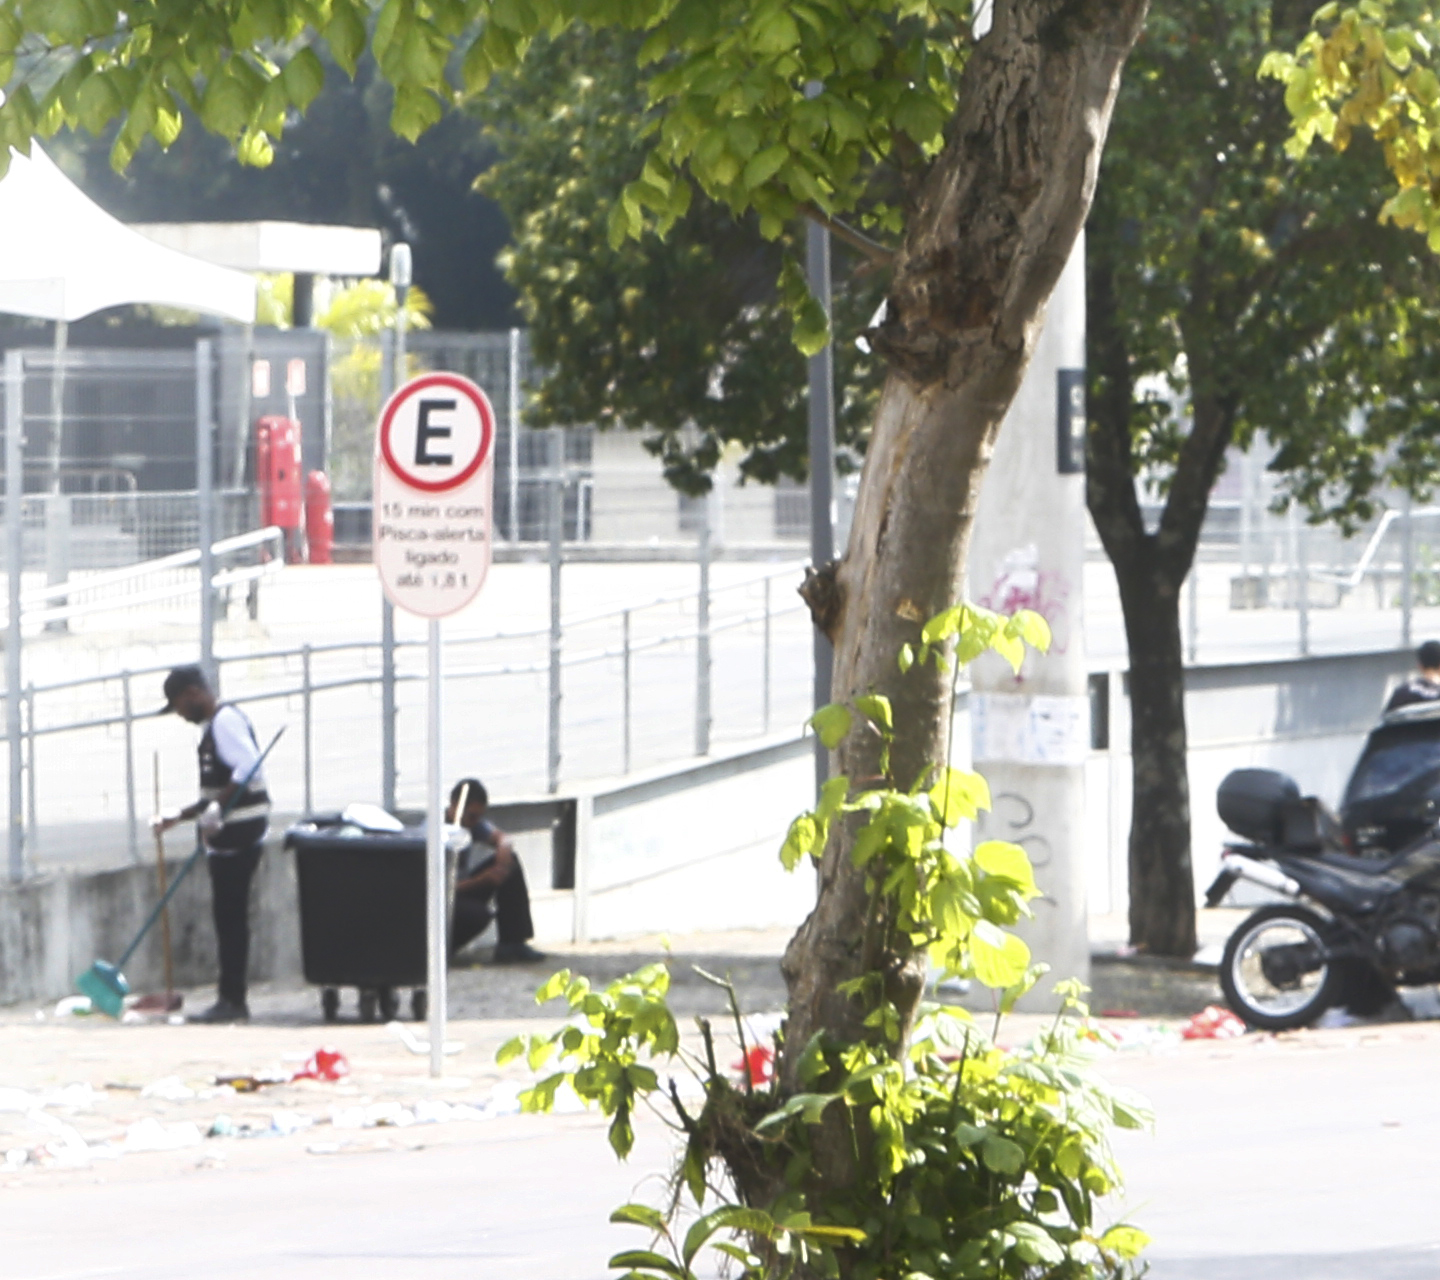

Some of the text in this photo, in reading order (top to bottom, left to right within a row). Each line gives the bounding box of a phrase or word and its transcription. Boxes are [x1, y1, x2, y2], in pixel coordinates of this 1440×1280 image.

[415, 399, 457, 466] E
[383, 504, 401, 518] 15
[444, 505, 485, 519] com
[404, 550, 459, 567] ligado
[396, 573, 424, 588] até
